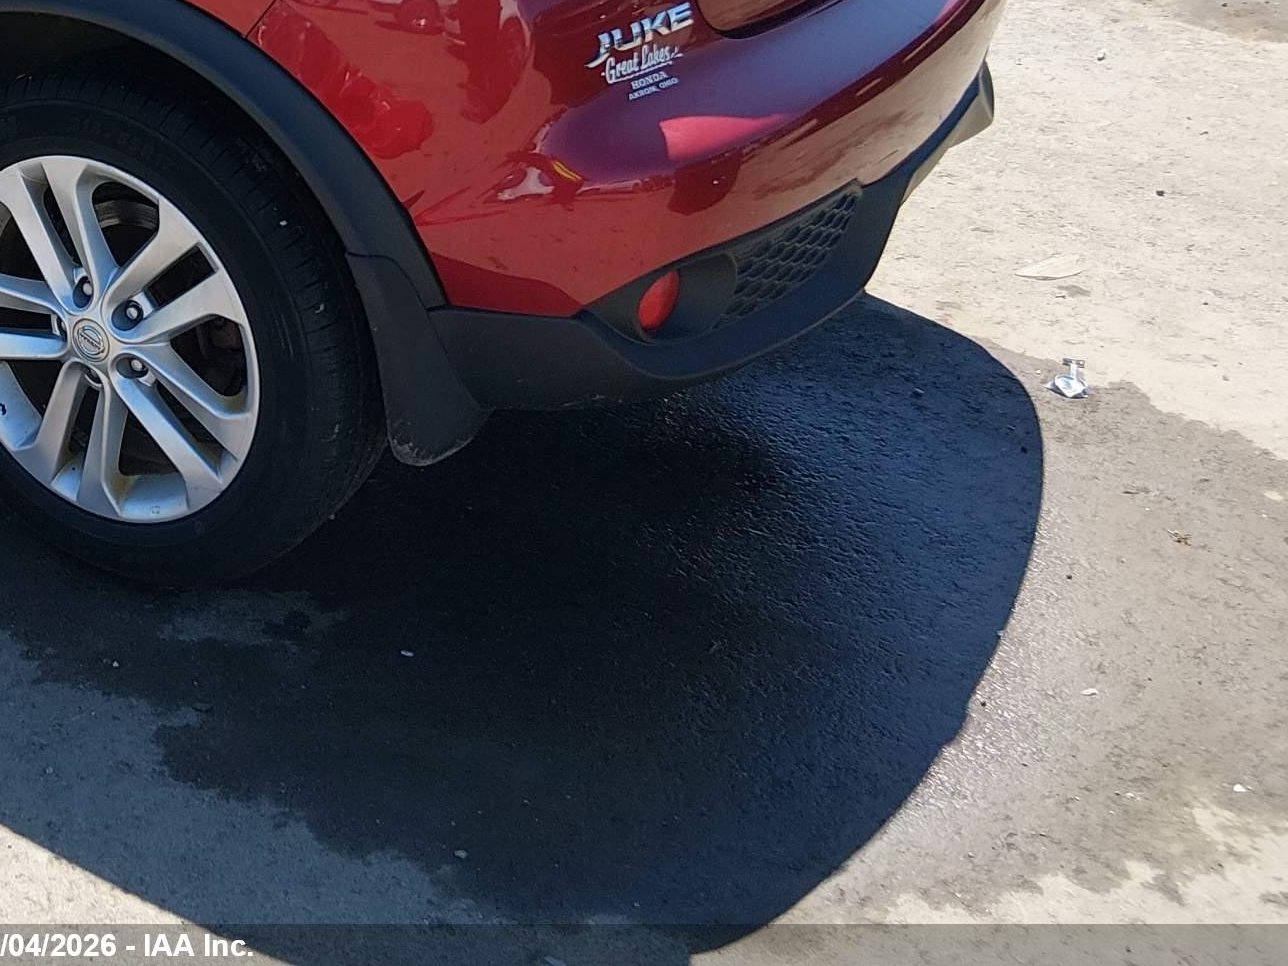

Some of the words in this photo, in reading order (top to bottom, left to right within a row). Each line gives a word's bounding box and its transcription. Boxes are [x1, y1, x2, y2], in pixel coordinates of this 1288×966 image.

[584, 1, 695, 69] JUKE
[605, 52, 640, 84] Great
[640, 44, 671, 70] Lakes
[631, 71, 669, 90] HONDA
[658, 77, 679, 89] OHIO
